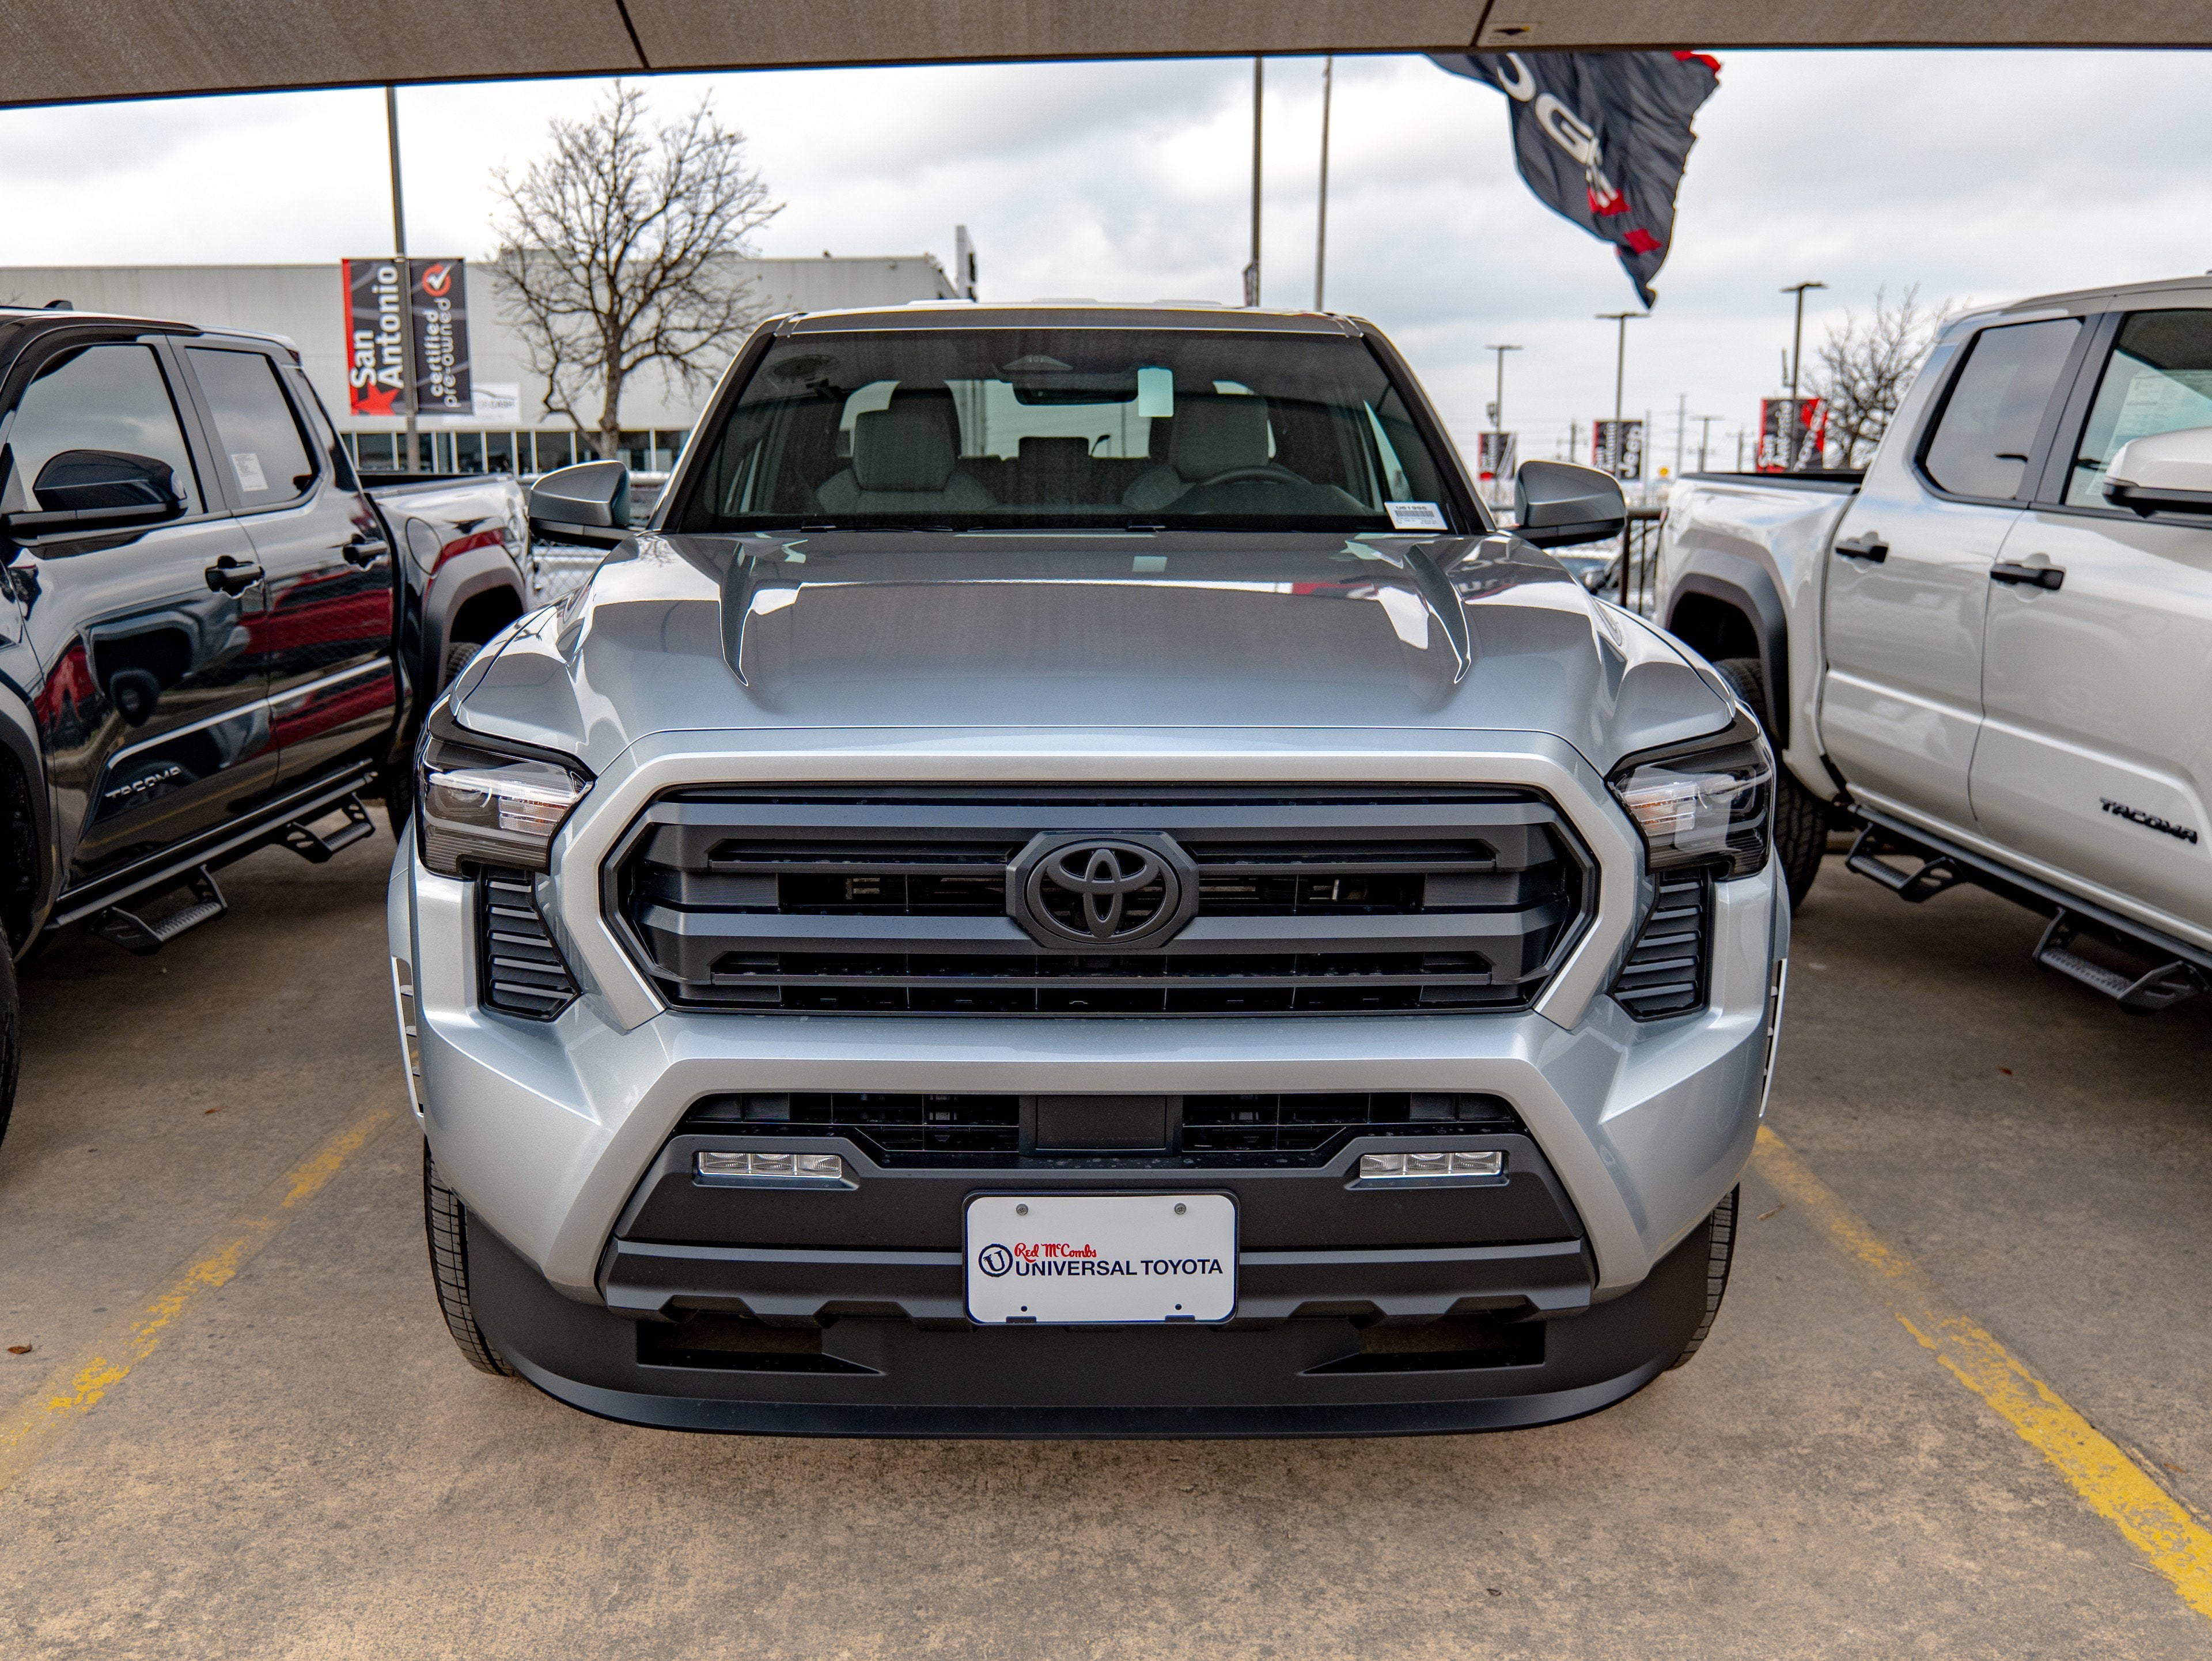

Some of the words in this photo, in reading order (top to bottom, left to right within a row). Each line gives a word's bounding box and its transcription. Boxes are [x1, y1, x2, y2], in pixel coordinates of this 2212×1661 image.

[372, 265, 404, 389] Antonio
[422, 309, 445, 397] certified
[434, 297, 461, 408] pre-owned
[350, 330, 377, 388] San
[1619, 425, 1642, 478] Jeep
[1758, 434, 1775, 468] San
[1774, 400, 1793, 469] Antonio
[104, 766, 182, 800] TACOMA
[2099, 796, 2198, 845] TACOMA
[1014, 1242, 1039, 1263] Red
[1040, 1243, 1097, 1258] McCombs
[1016, 1260, 1138, 1276] UNIVERSAL
[1140, 1258, 1224, 1275] TOYOTA
